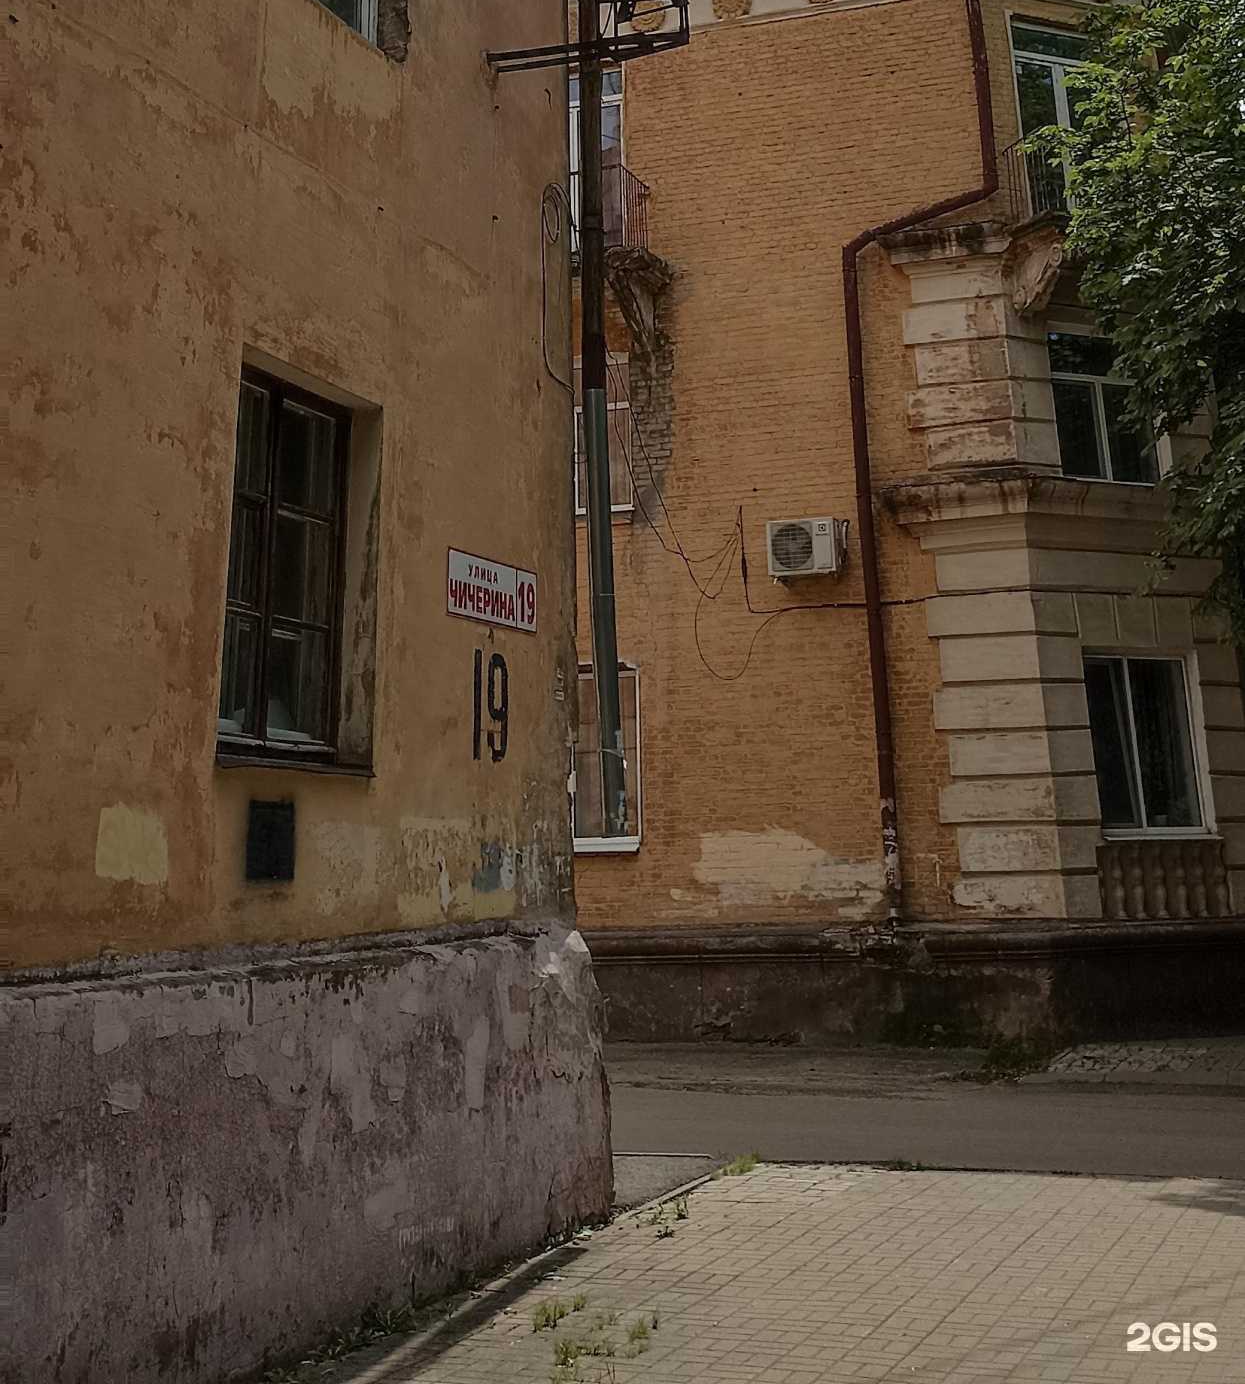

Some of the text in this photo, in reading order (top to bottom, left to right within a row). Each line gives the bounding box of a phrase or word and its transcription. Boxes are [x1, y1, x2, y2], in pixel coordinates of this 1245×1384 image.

[468, 563, 499, 585] УЛИЦА
[449, 578, 536, 625] ЧИЧЕРИНА 19
[472, 648, 509, 764] 19
